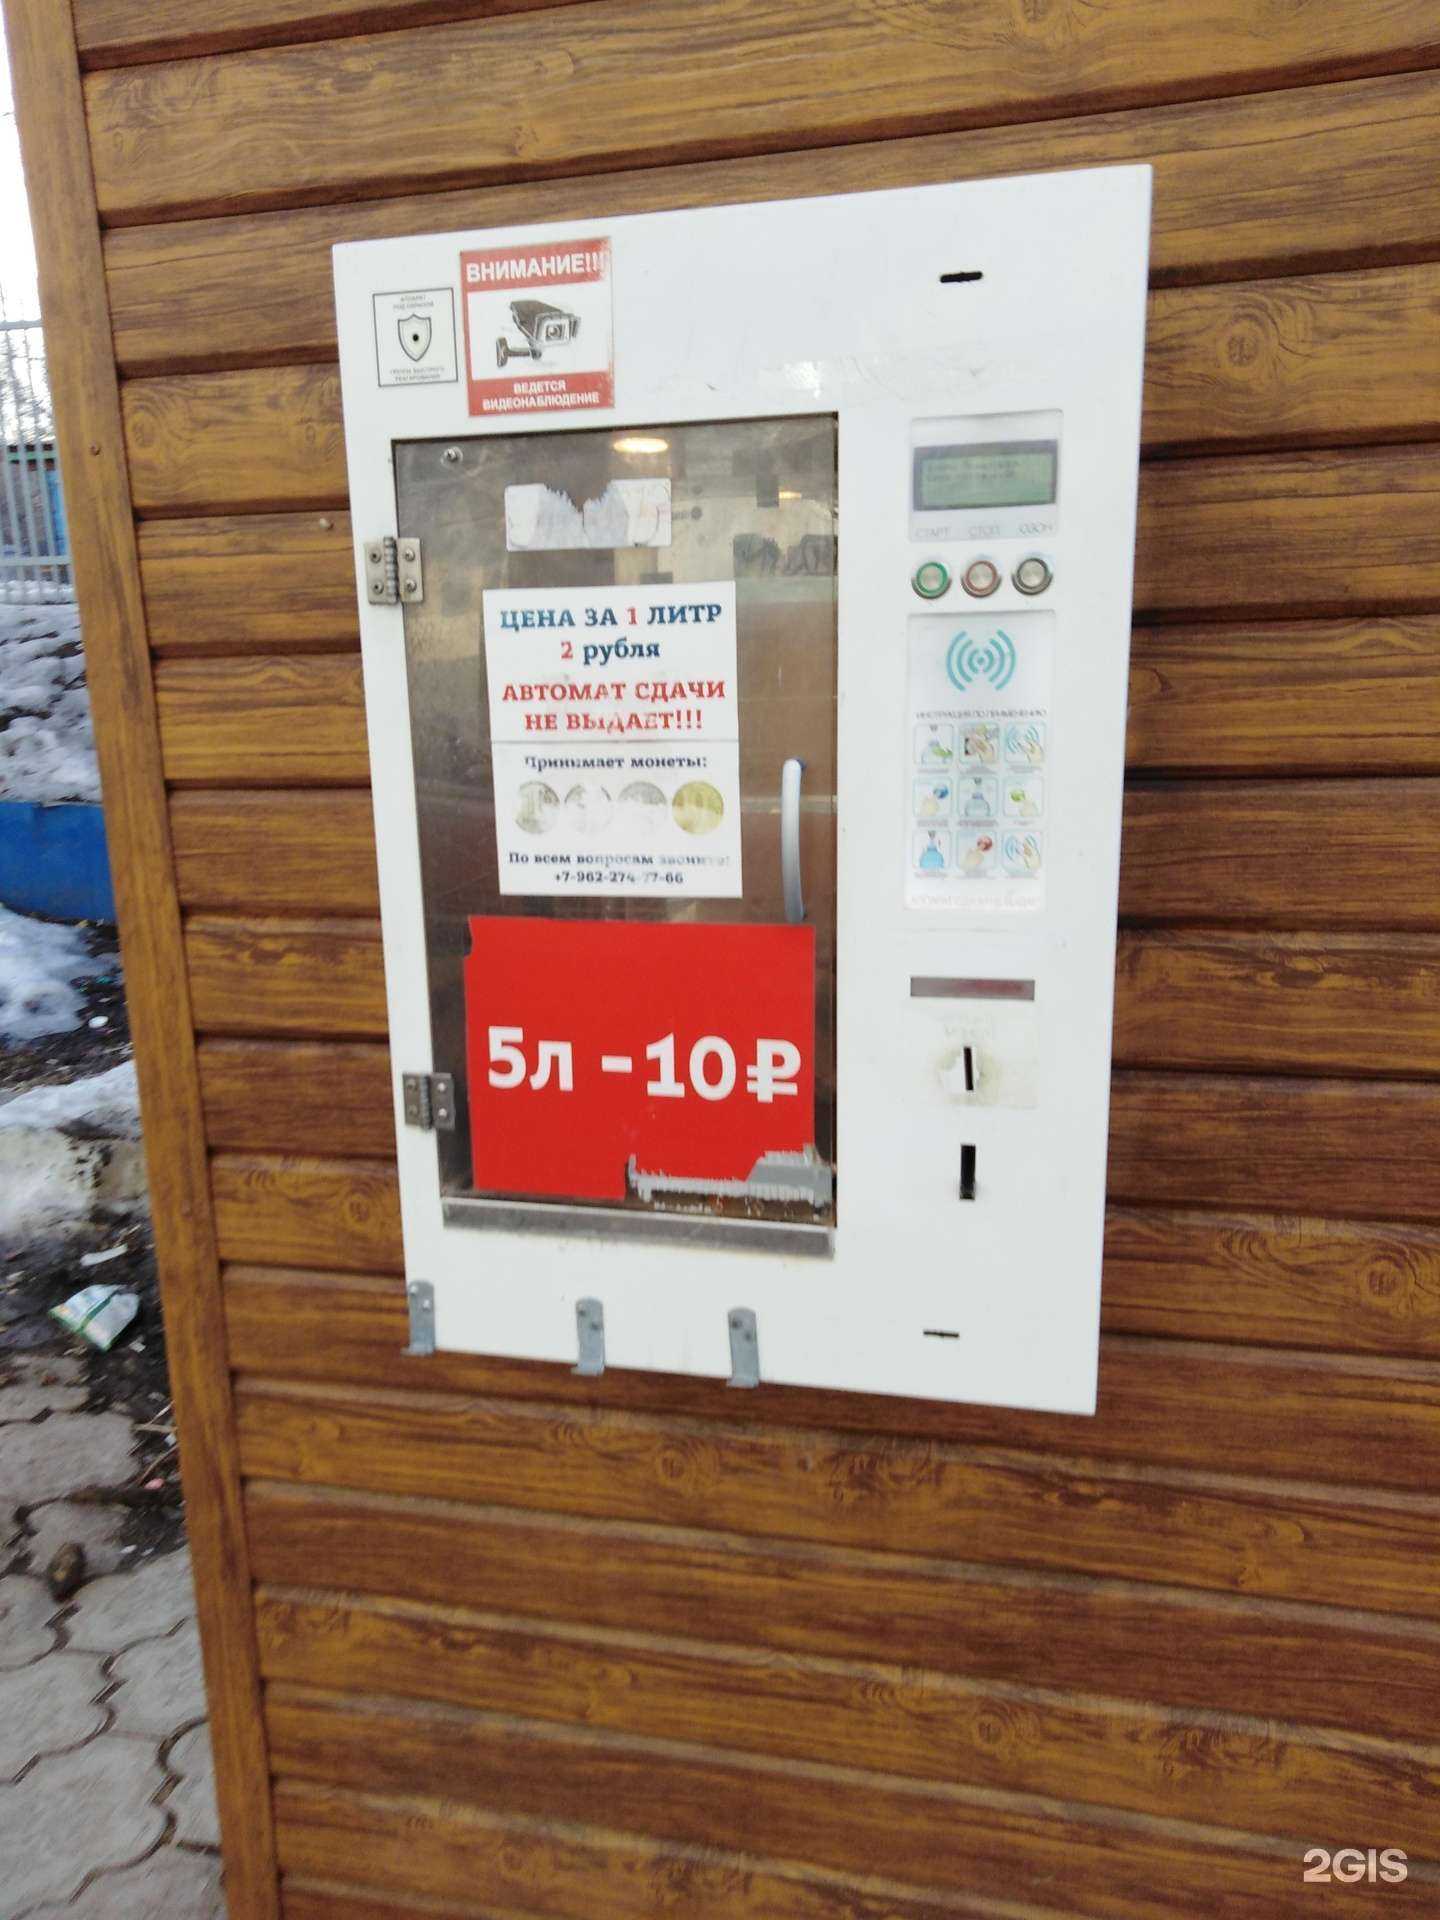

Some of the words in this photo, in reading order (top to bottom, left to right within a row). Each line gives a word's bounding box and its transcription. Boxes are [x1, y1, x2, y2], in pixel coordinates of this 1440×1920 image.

[513, 378, 567, 395] ВЕДЕТСЯ
[482, 391, 600, 410] ВИДЕОНАБЛЮДЕНИЕ
[500, 608, 576, 632] ЦЕНА
[584, 608, 618, 627] ЗА
[627, 607, 638, 626] 1
[647, 603, 722, 625] ЛИТР
[560, 641, 574, 660] 2
[583, 637, 660, 666] рубля
[502, 682, 627, 702] АВТОМАТ
[635, 679, 726, 703] СДАЧИ
[525, 714, 558, 731] НЕ
[566, 709, 703, 734] ВЫДАЕТ!!!
[525, 755, 625, 773] Принимает
[630, 754, 708, 769] монеты:
[509, 851, 529, 865] По
[534, 852, 571, 865] всем
[577, 853, 653, 869] вопросам
[487, 1024, 574, 1092] 5л
